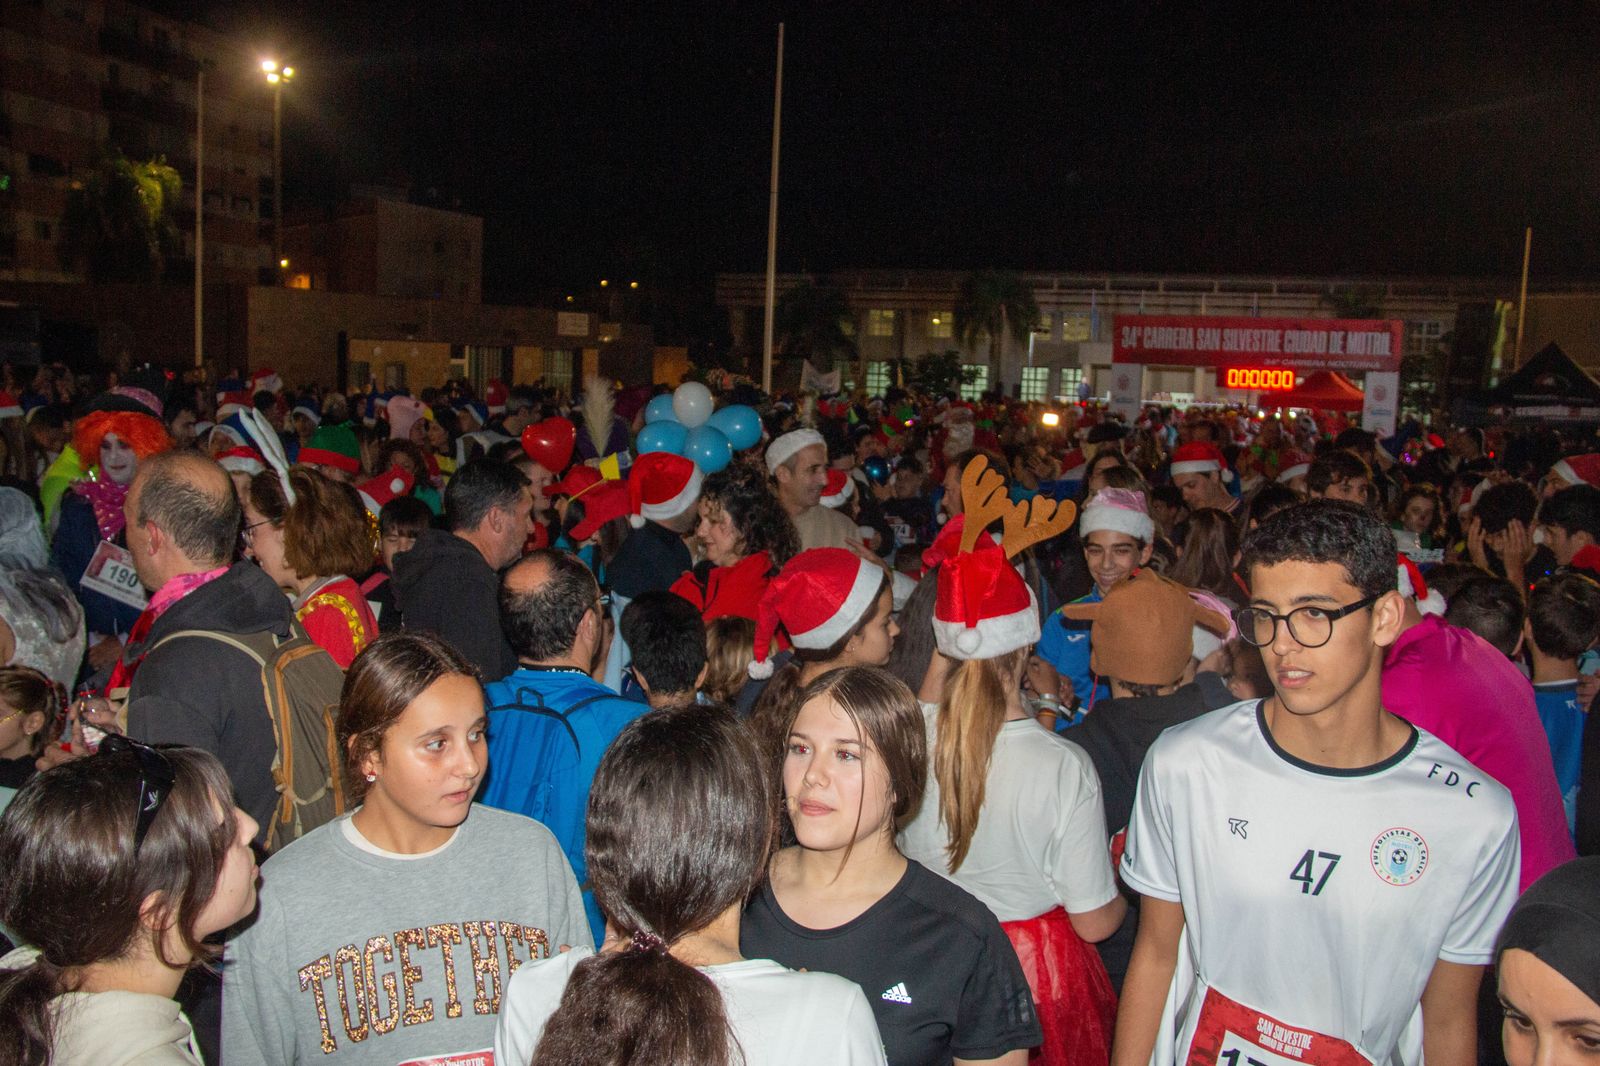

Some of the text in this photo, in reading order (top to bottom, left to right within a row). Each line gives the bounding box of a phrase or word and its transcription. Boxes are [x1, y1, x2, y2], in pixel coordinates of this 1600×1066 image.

[1143, 325, 1194, 350] CARRERA
[1196, 326, 1220, 351] SAN
[1222, 328, 1281, 353] SILVESTRE
[1283, 330, 1328, 354] CIUDAD
[1328, 331, 1346, 355] DE
[1345, 332, 1393, 356] MOTRIL
[110, 564, 138, 588] 190
[1289, 848, 1342, 896] 47
[1256, 1017, 1313, 1050] SAN SILVESTRE
